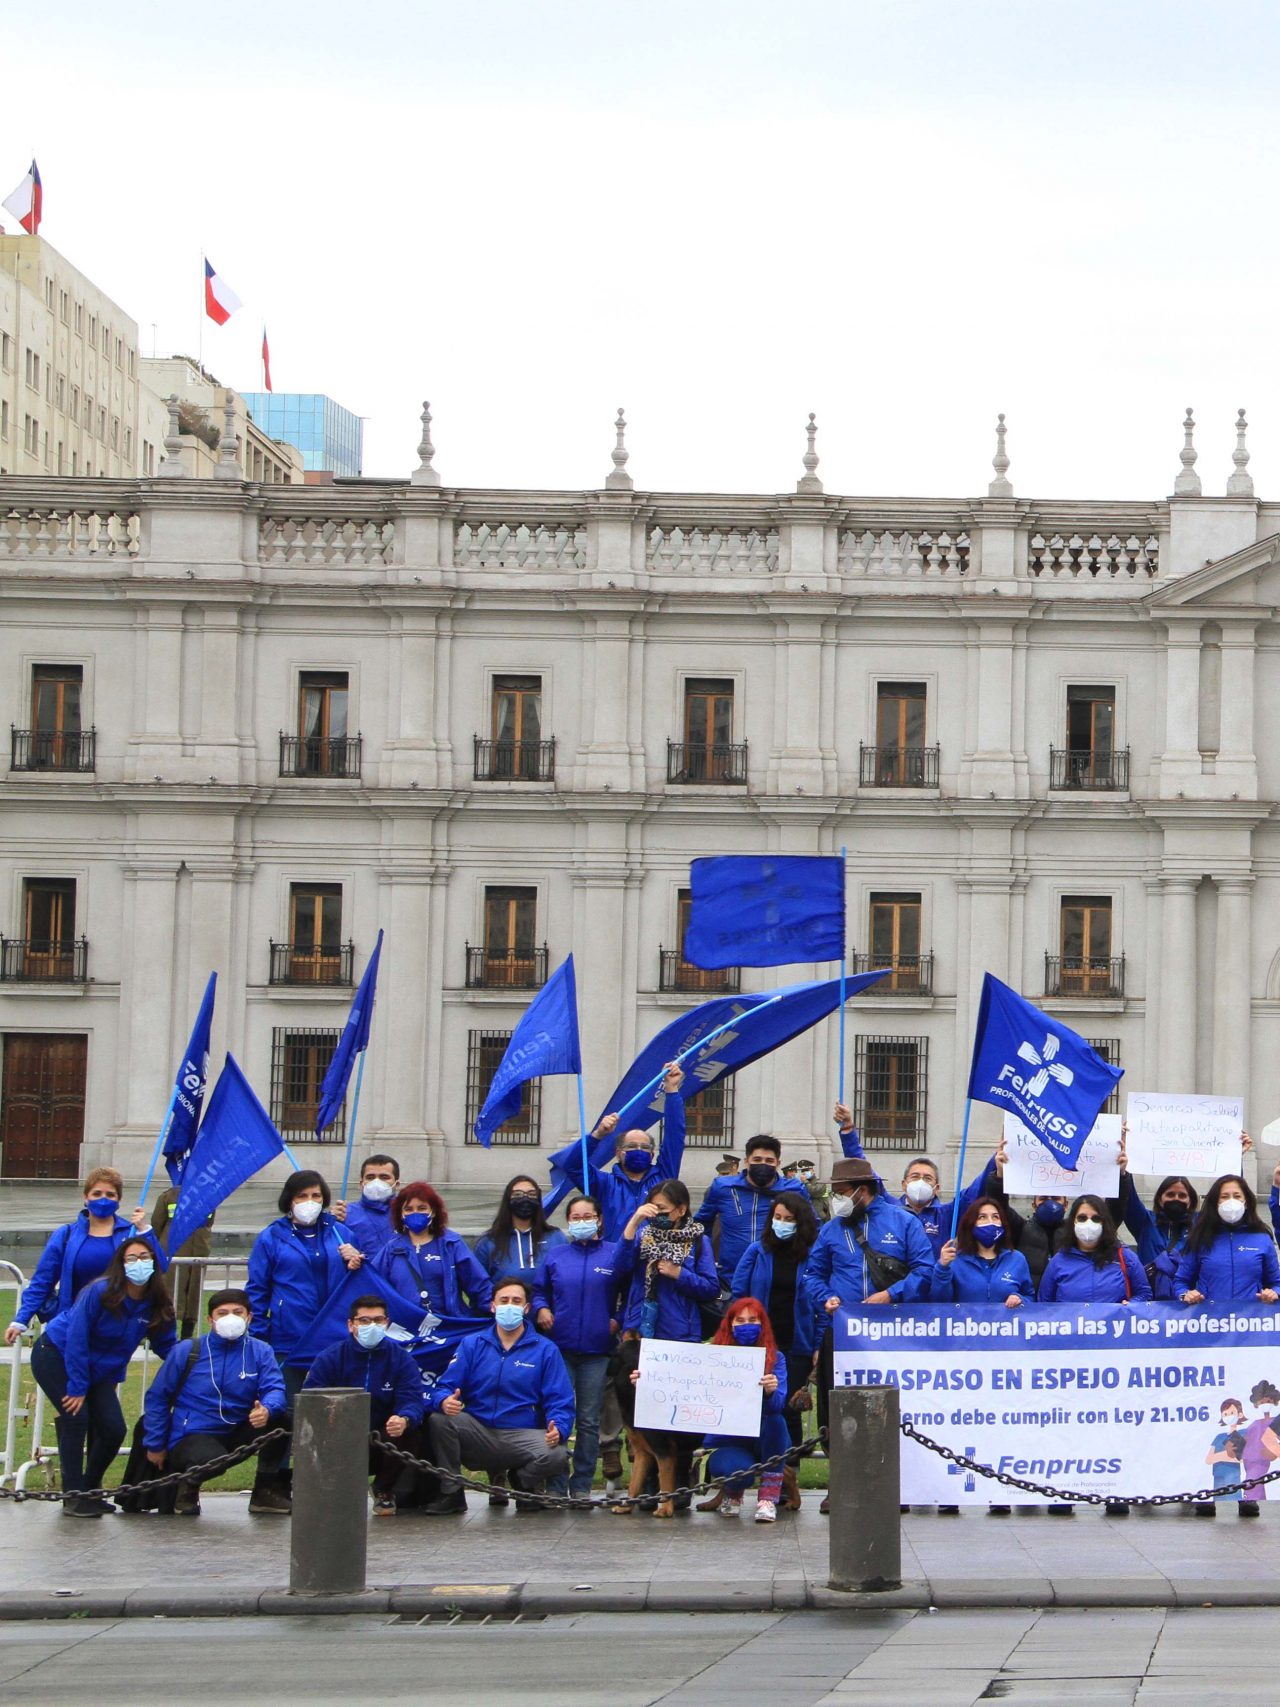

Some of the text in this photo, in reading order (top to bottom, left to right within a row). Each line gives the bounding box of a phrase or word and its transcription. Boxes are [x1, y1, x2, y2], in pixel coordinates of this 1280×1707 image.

[997, 1064, 1078, 1138] Fenruss
[847, 1318, 940, 1340] Dignidad
[947, 1317, 1019, 1337] laboral
[1025, 1320, 1071, 1340] para
[1078, 1316, 1106, 1335] las
[1113, 1320, 1126, 1338] y
[1131, 1315, 1159, 1334] los
[844, 1365, 1225, 1390] ¡TRASPASO EN ESPEJO AHORA!
[653, 1389, 720, 1404] Oriente
[902, 1406, 1210, 1427] erno debe cumplir con Ley 21.106
[998, 1456, 1122, 1479] Fenpruss
